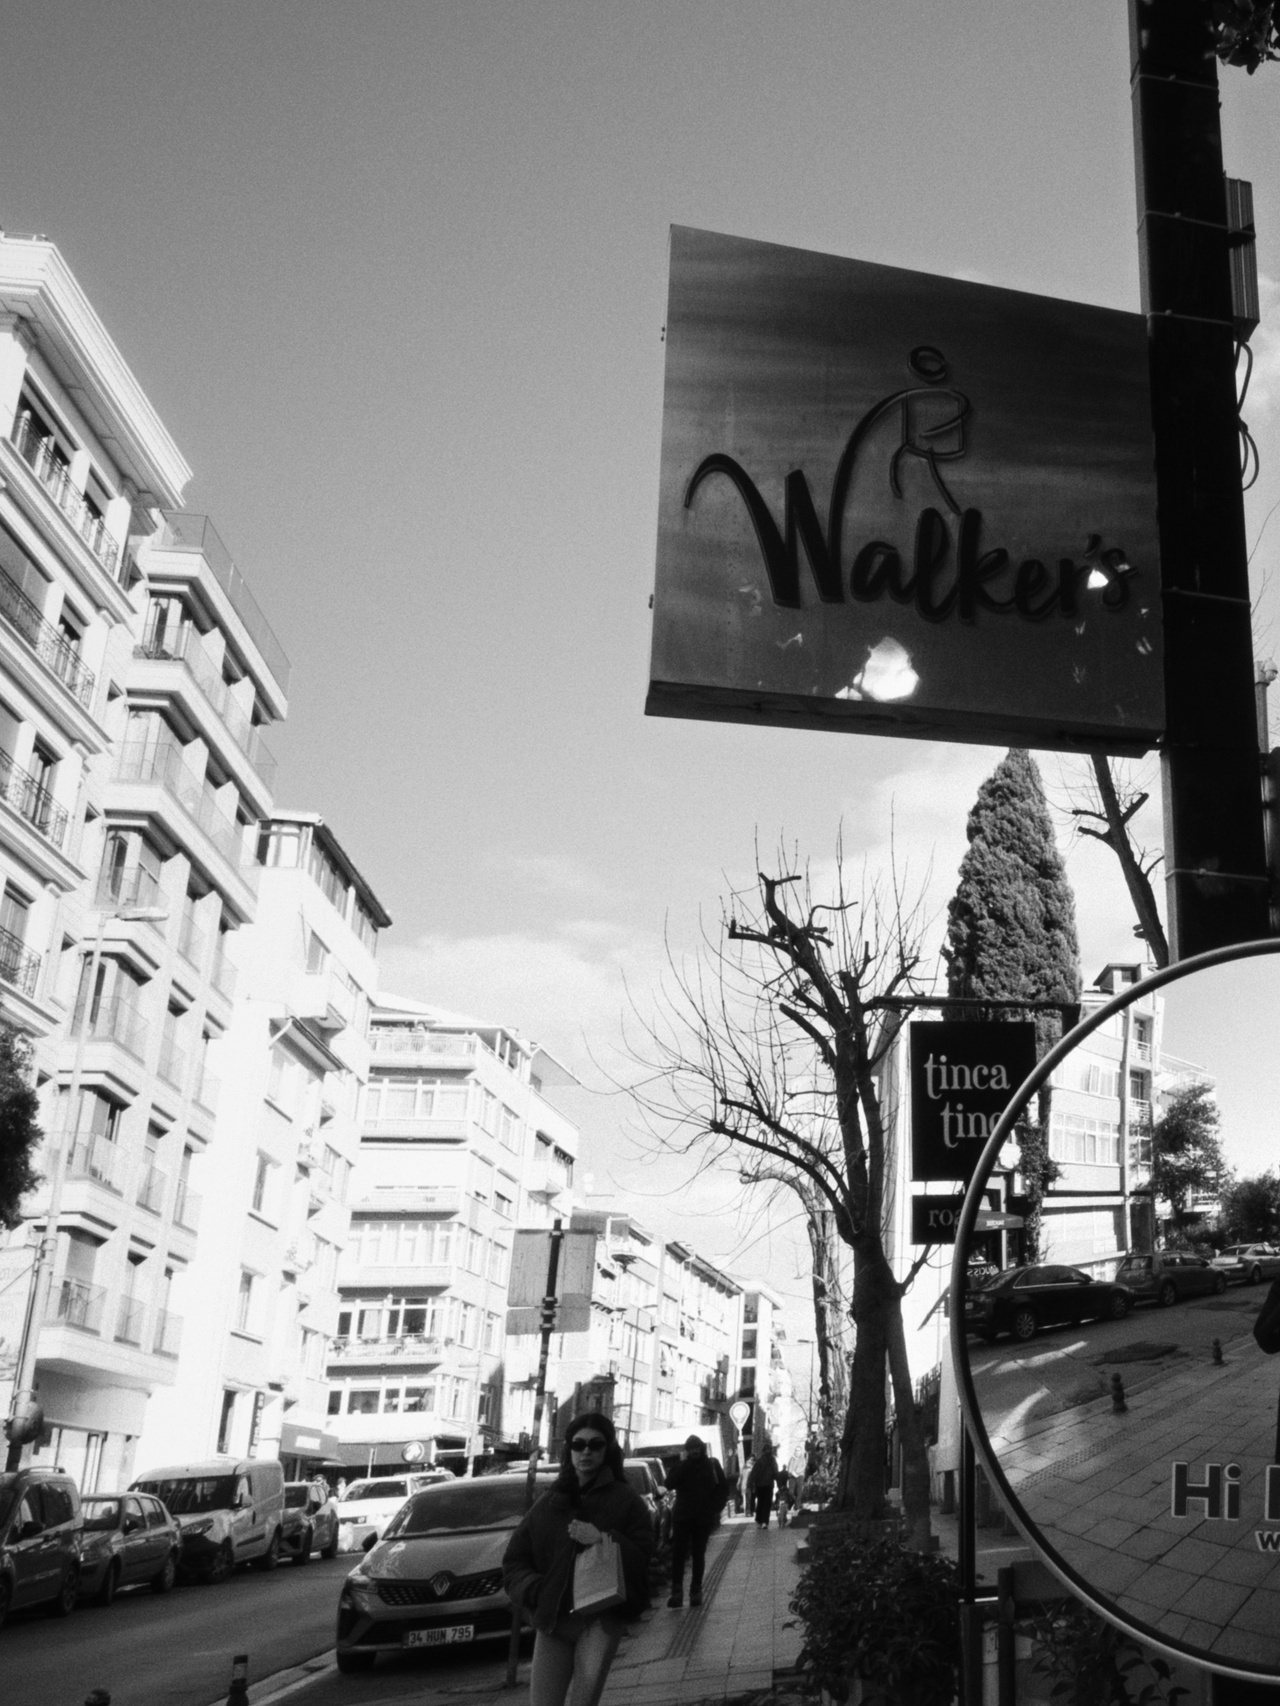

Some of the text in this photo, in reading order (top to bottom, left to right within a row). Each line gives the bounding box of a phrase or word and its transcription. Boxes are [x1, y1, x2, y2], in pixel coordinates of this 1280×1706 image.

[684, 388, 1137, 625] Walker's
[923, 1053, 1011, 1100] tinca
[940, 1102, 1004, 1148] tinc
[1171, 1461, 1242, 1521] Hi
[410, 1631, 423, 1644] 34
[451, 1626, 471, 1640] 795
